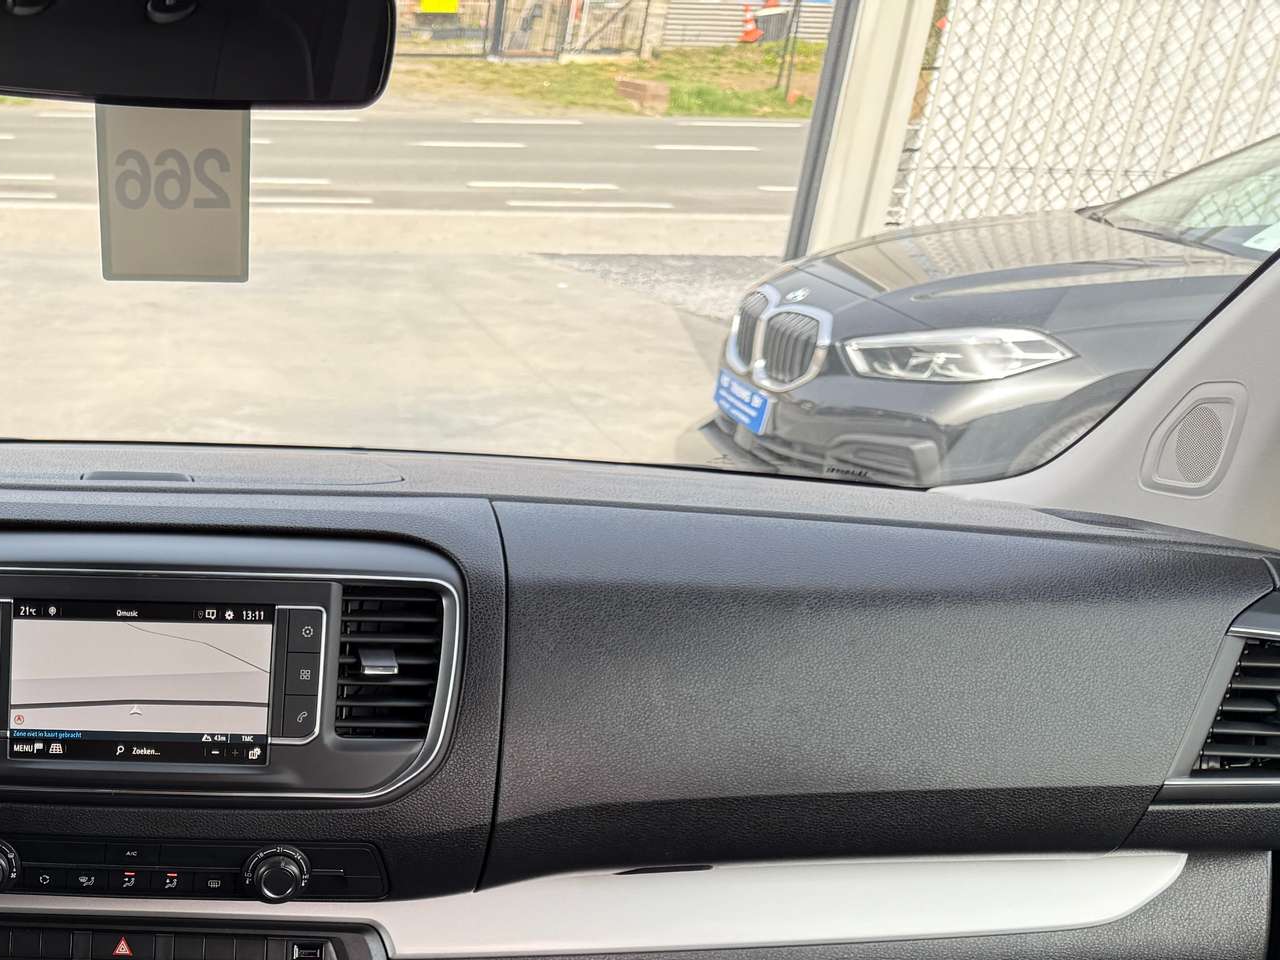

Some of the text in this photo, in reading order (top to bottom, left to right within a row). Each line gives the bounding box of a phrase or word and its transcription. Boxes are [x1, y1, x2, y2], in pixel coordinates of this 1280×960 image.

[116, 609, 139, 617] Qmusic
[242, 610, 264, 620] 13:11
[13, 744, 33, 752] MENU
